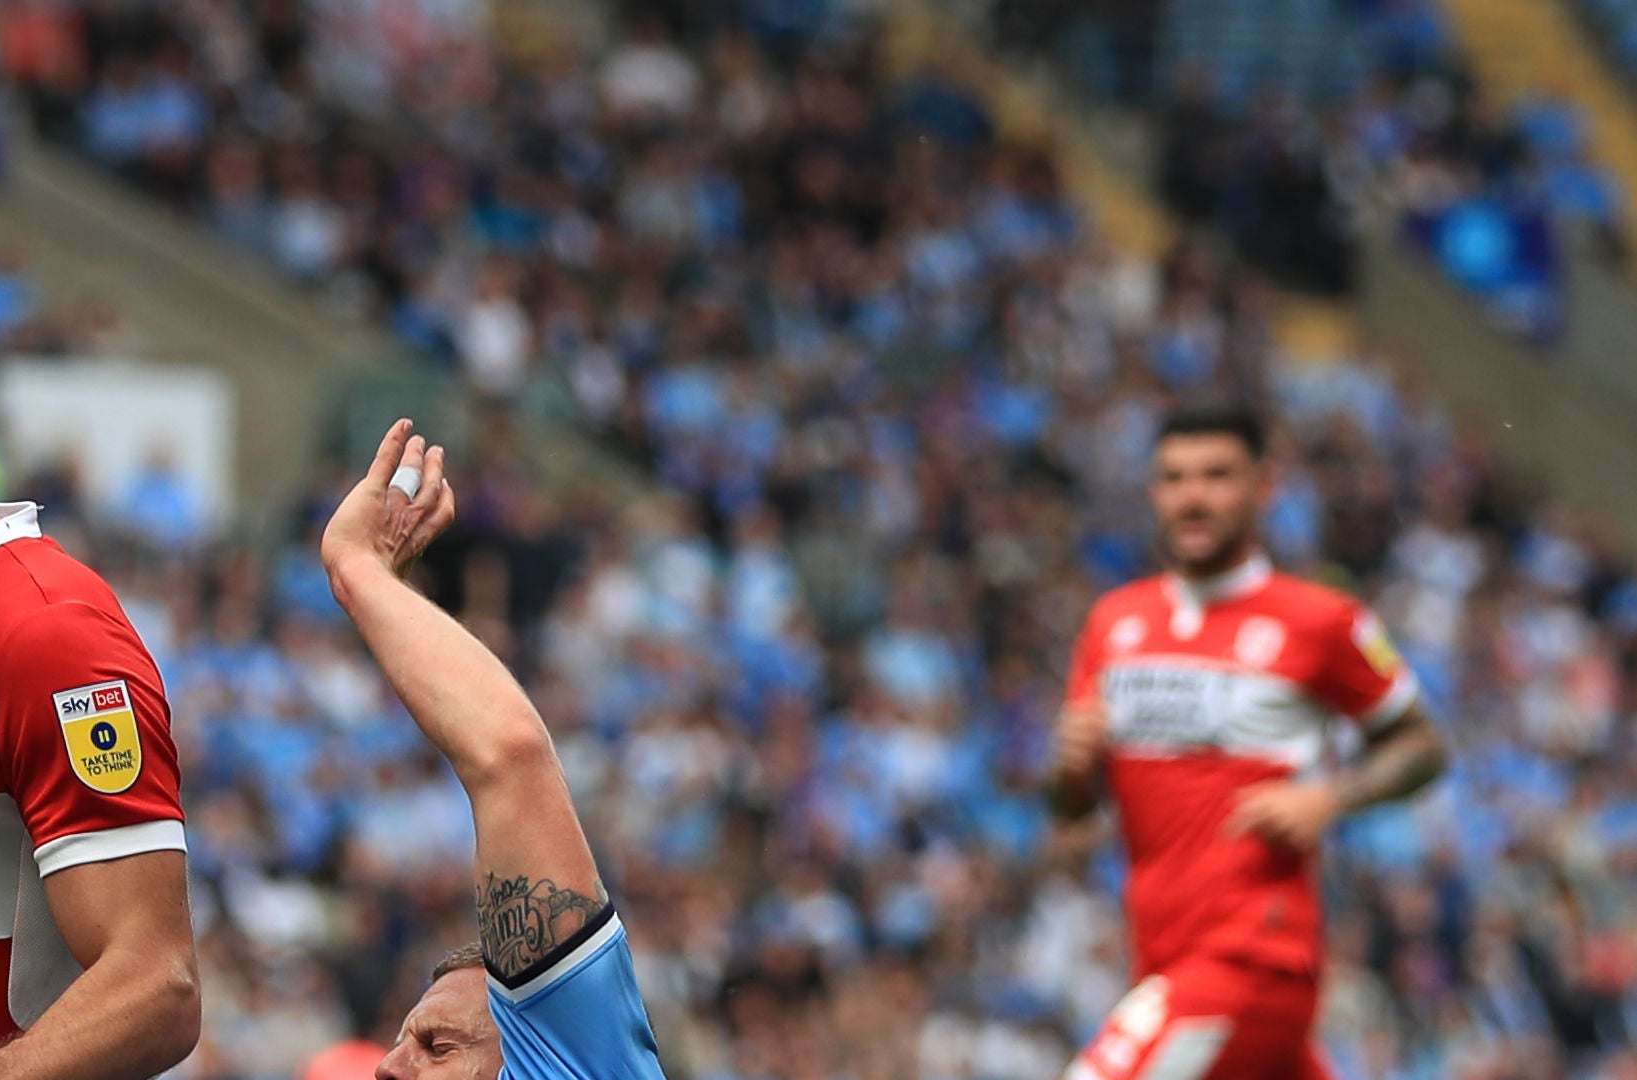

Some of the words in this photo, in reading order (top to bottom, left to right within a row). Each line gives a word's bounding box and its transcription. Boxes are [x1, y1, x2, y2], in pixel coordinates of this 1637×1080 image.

[62, 697, 90, 713] sky
[96, 691, 122, 706] bet
[81, 753, 108, 768] TAKE
[110, 749, 133, 761] TIME
[86, 765, 102, 777] TO
[102, 760, 134, 774] THINK
